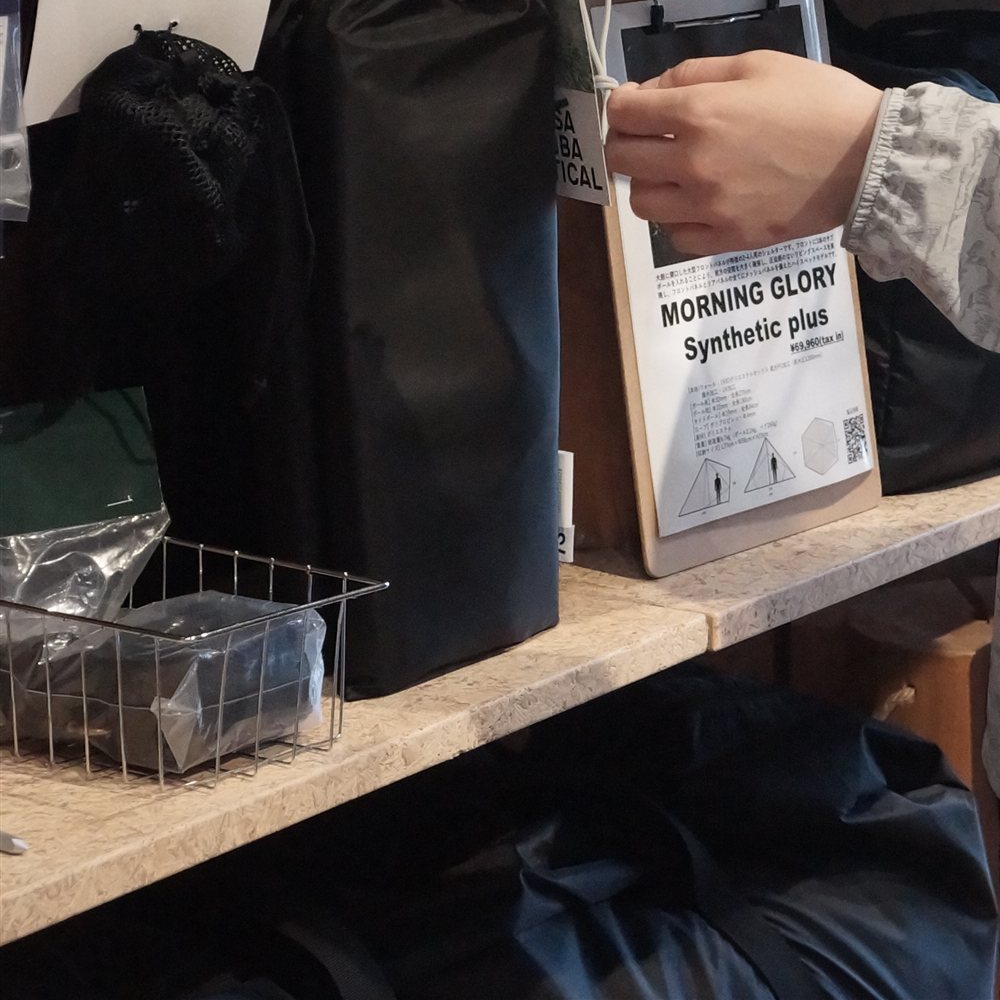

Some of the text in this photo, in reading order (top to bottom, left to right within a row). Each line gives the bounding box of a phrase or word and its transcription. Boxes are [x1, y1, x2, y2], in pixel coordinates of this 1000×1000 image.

[557, 135, 583, 161] BA
[557, 158, 603, 191] ICAL
[660, 263, 837, 328] MORNING GLORY
[684, 307, 828, 364] Synthetic plus
